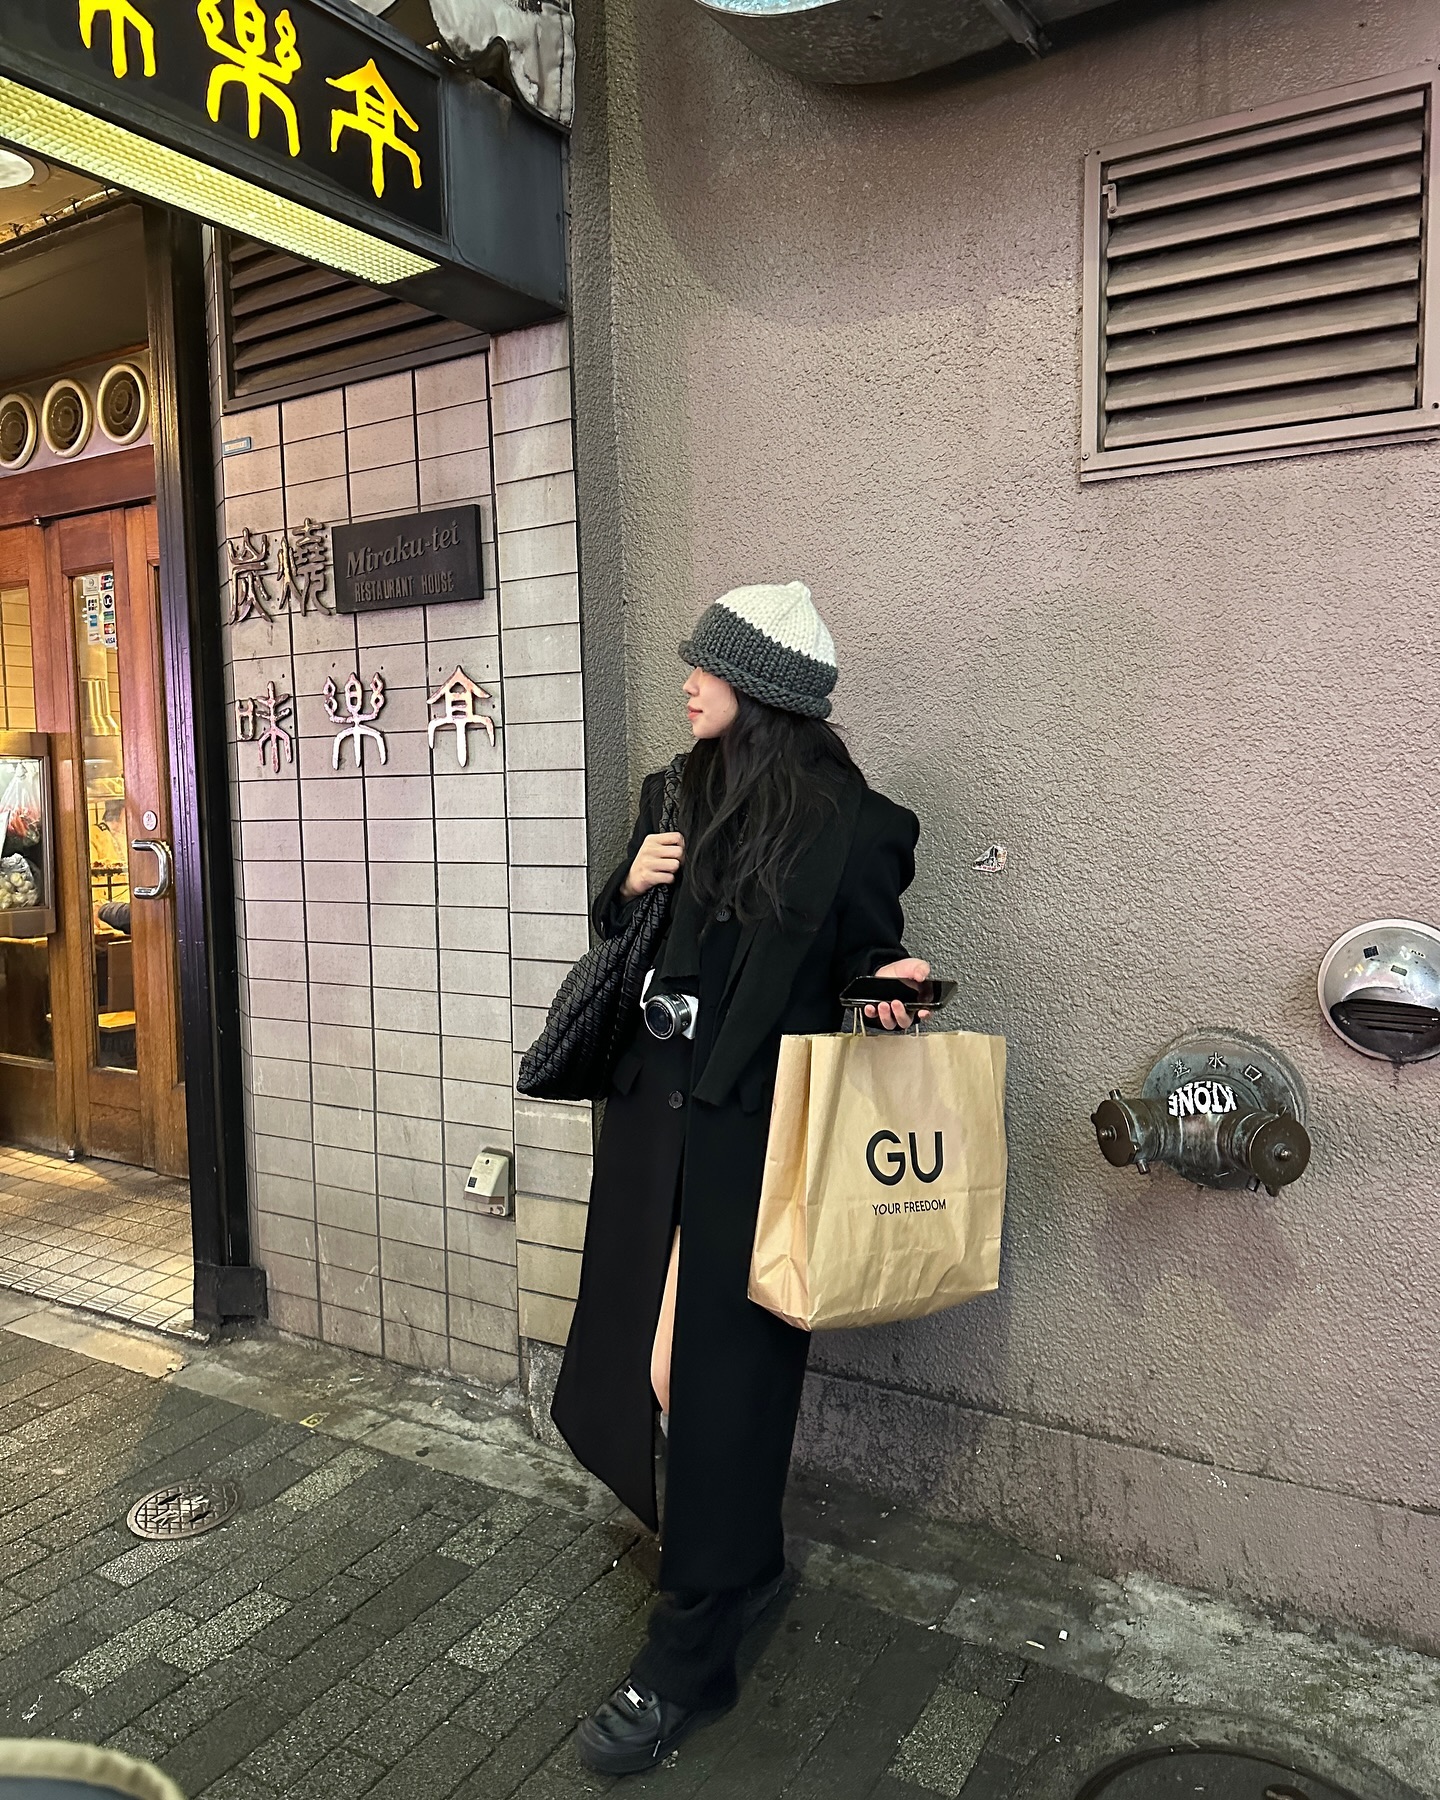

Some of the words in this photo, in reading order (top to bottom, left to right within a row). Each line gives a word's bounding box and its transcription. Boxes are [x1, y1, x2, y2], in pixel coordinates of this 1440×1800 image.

[346, 520, 461, 579] Miraku-tei
[354, 574, 414, 603] RESTAURANT
[422, 570, 454, 595] HOUSE
[866, 1129, 944, 1186] GU
[872, 1202, 901, 1215] YOUR
[904, 1198, 946, 1213] FREEDOM
